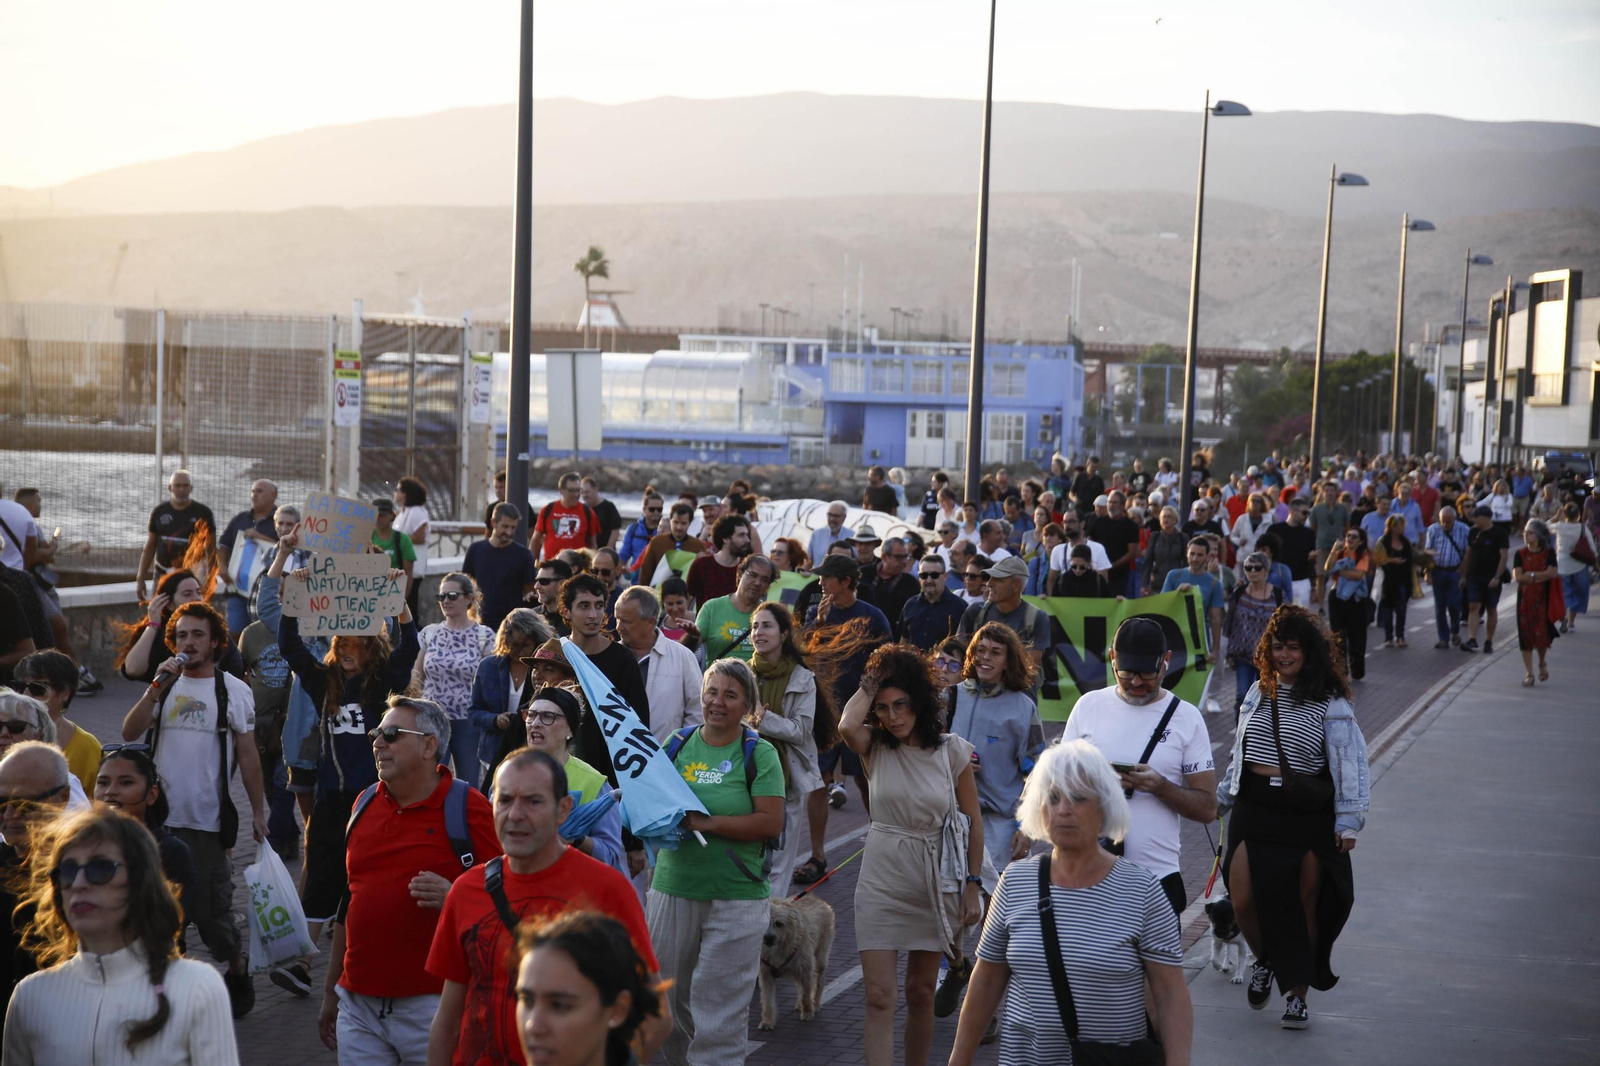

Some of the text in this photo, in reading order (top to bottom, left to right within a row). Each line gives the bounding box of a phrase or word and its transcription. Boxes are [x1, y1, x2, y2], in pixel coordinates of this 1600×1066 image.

[310, 494, 374, 522] LA TIERRA
[304, 516, 354, 541] NO SE
[313, 557, 335, 575] LA
[306, 573, 401, 596] NATURALEZA
[310, 595, 378, 613] NO TIENE
[317, 614, 370, 630] DUEÑO
